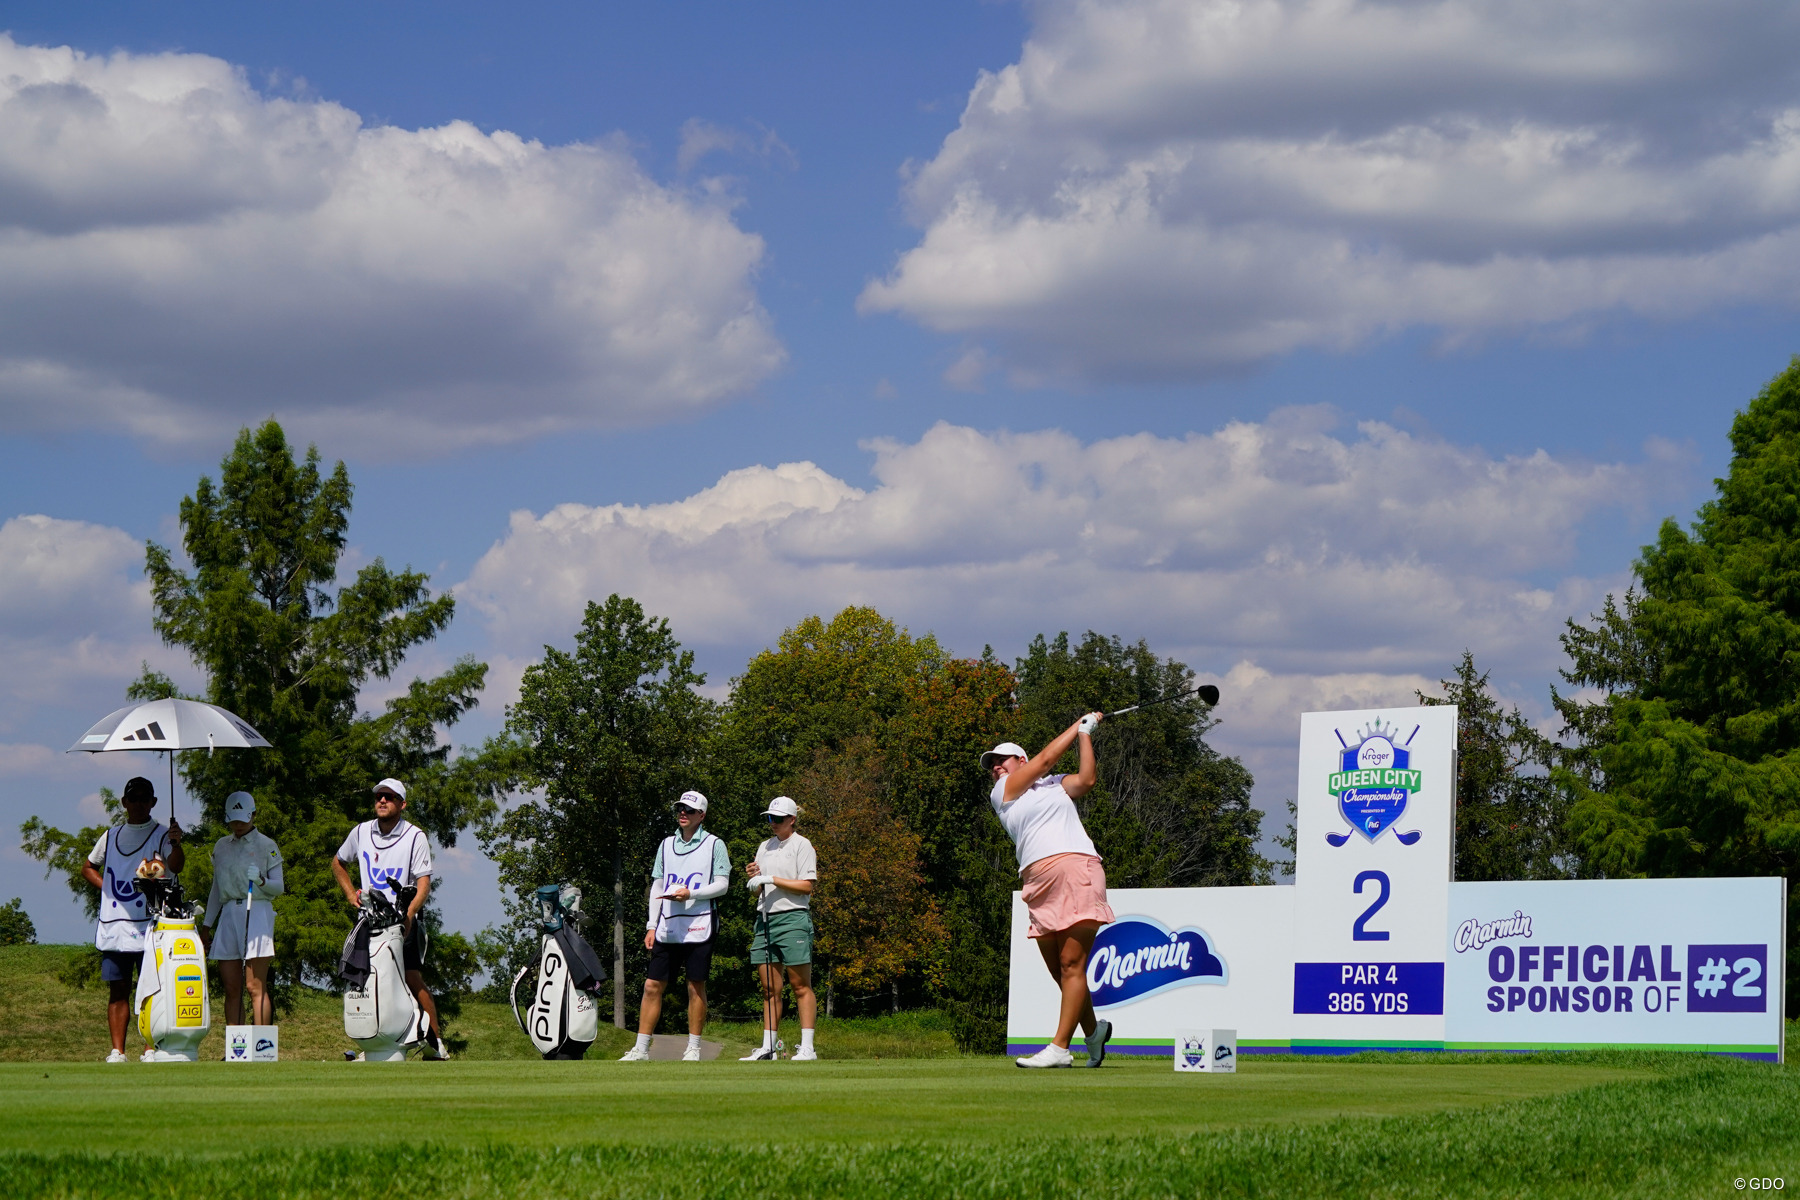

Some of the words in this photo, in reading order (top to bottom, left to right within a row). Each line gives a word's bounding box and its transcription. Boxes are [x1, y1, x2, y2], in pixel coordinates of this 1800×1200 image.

[1362, 748, 1389, 765] Kroger
[1331, 769, 1380, 790] QUEEN
[1384, 769, 1419, 787] CITY
[1344, 786, 1403, 807] Championship
[1353, 870, 1390, 941] 2
[1453, 910, 1533, 953] Charmin
[1086, 932, 1192, 993] Charmin
[1488, 944, 1682, 983] OFFICIAL
[1341, 965, 1379, 985] PAR
[1385, 965, 1398, 985] 4
[1693, 957, 1762, 998] #2
[1328, 992, 1365, 1012] 386
[1371, 992, 1409, 1013] YDS
[1486, 985, 1633, 1013] SPONSOR
[1643, 985, 1681, 1013] OF
[180, 1007, 199, 1016] AIG
